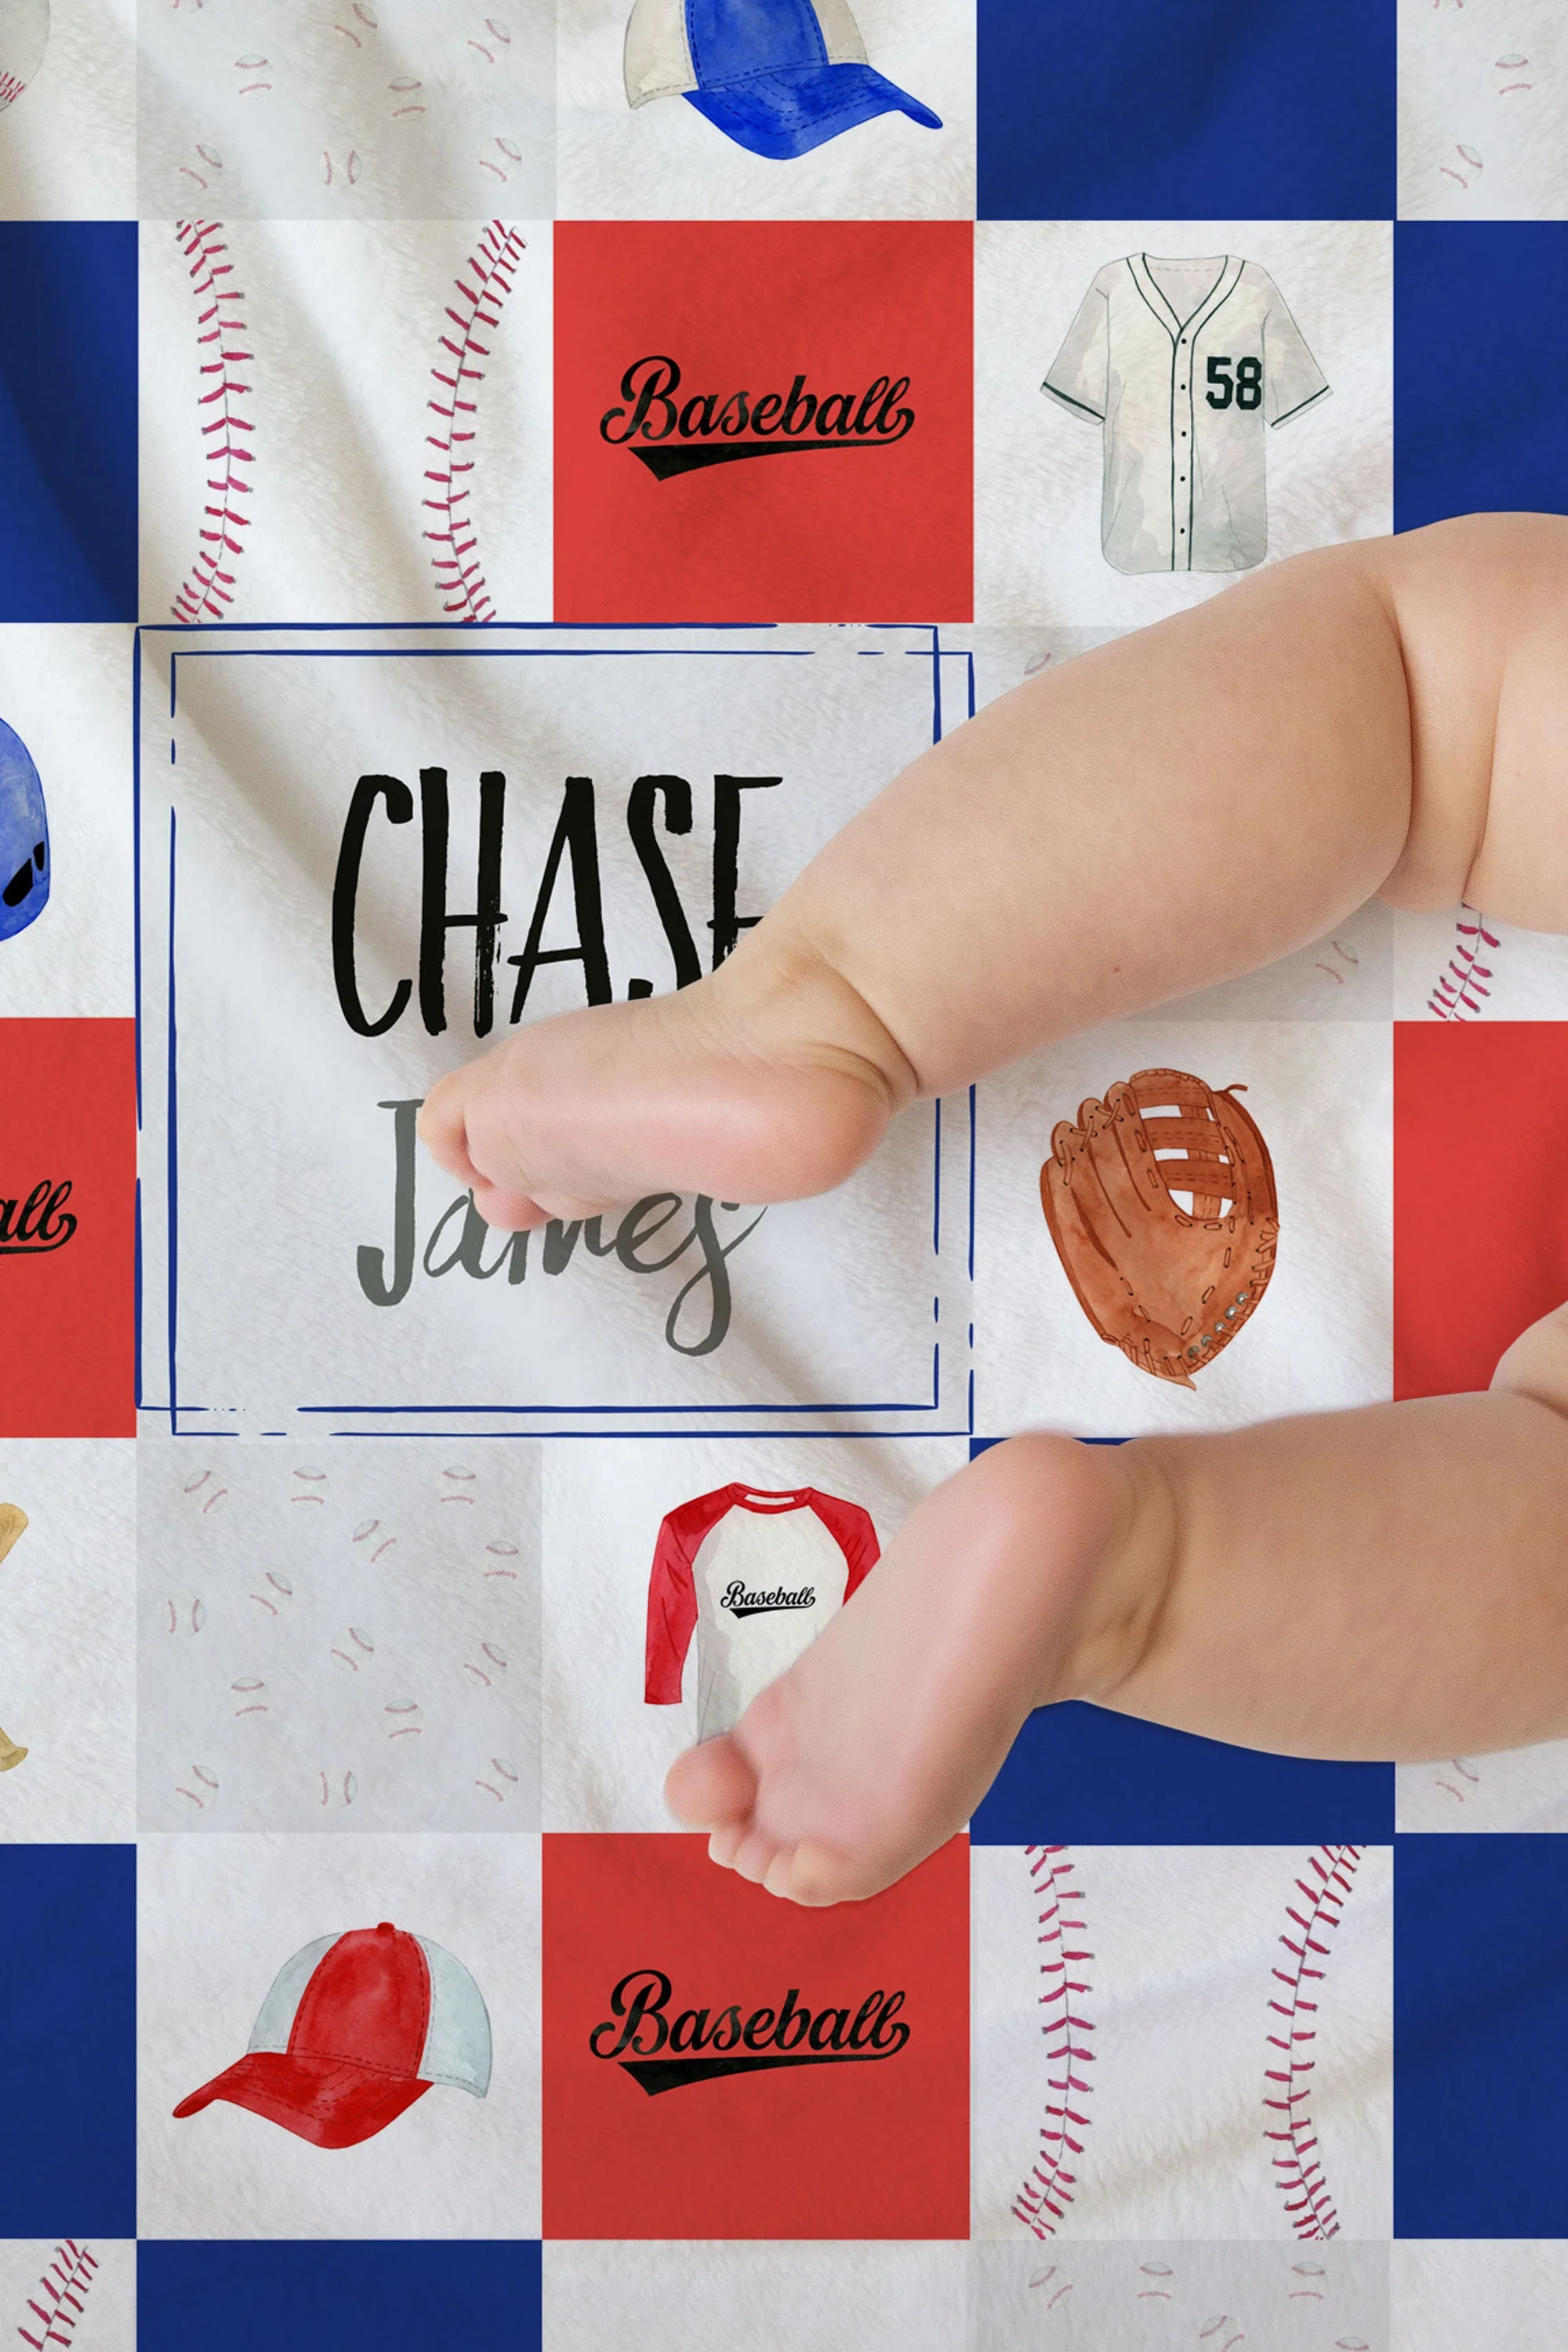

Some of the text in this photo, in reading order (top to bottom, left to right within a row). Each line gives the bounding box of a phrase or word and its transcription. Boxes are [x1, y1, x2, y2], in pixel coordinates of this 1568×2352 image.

[601, 356, 915, 451] Baseball
[1206, 357, 1261, 410] 58
[332, 767, 782, 1038] CHASE
[720, 1580, 816, 1611] Baseball
[590, 1970, 911, 2065] Baseball
